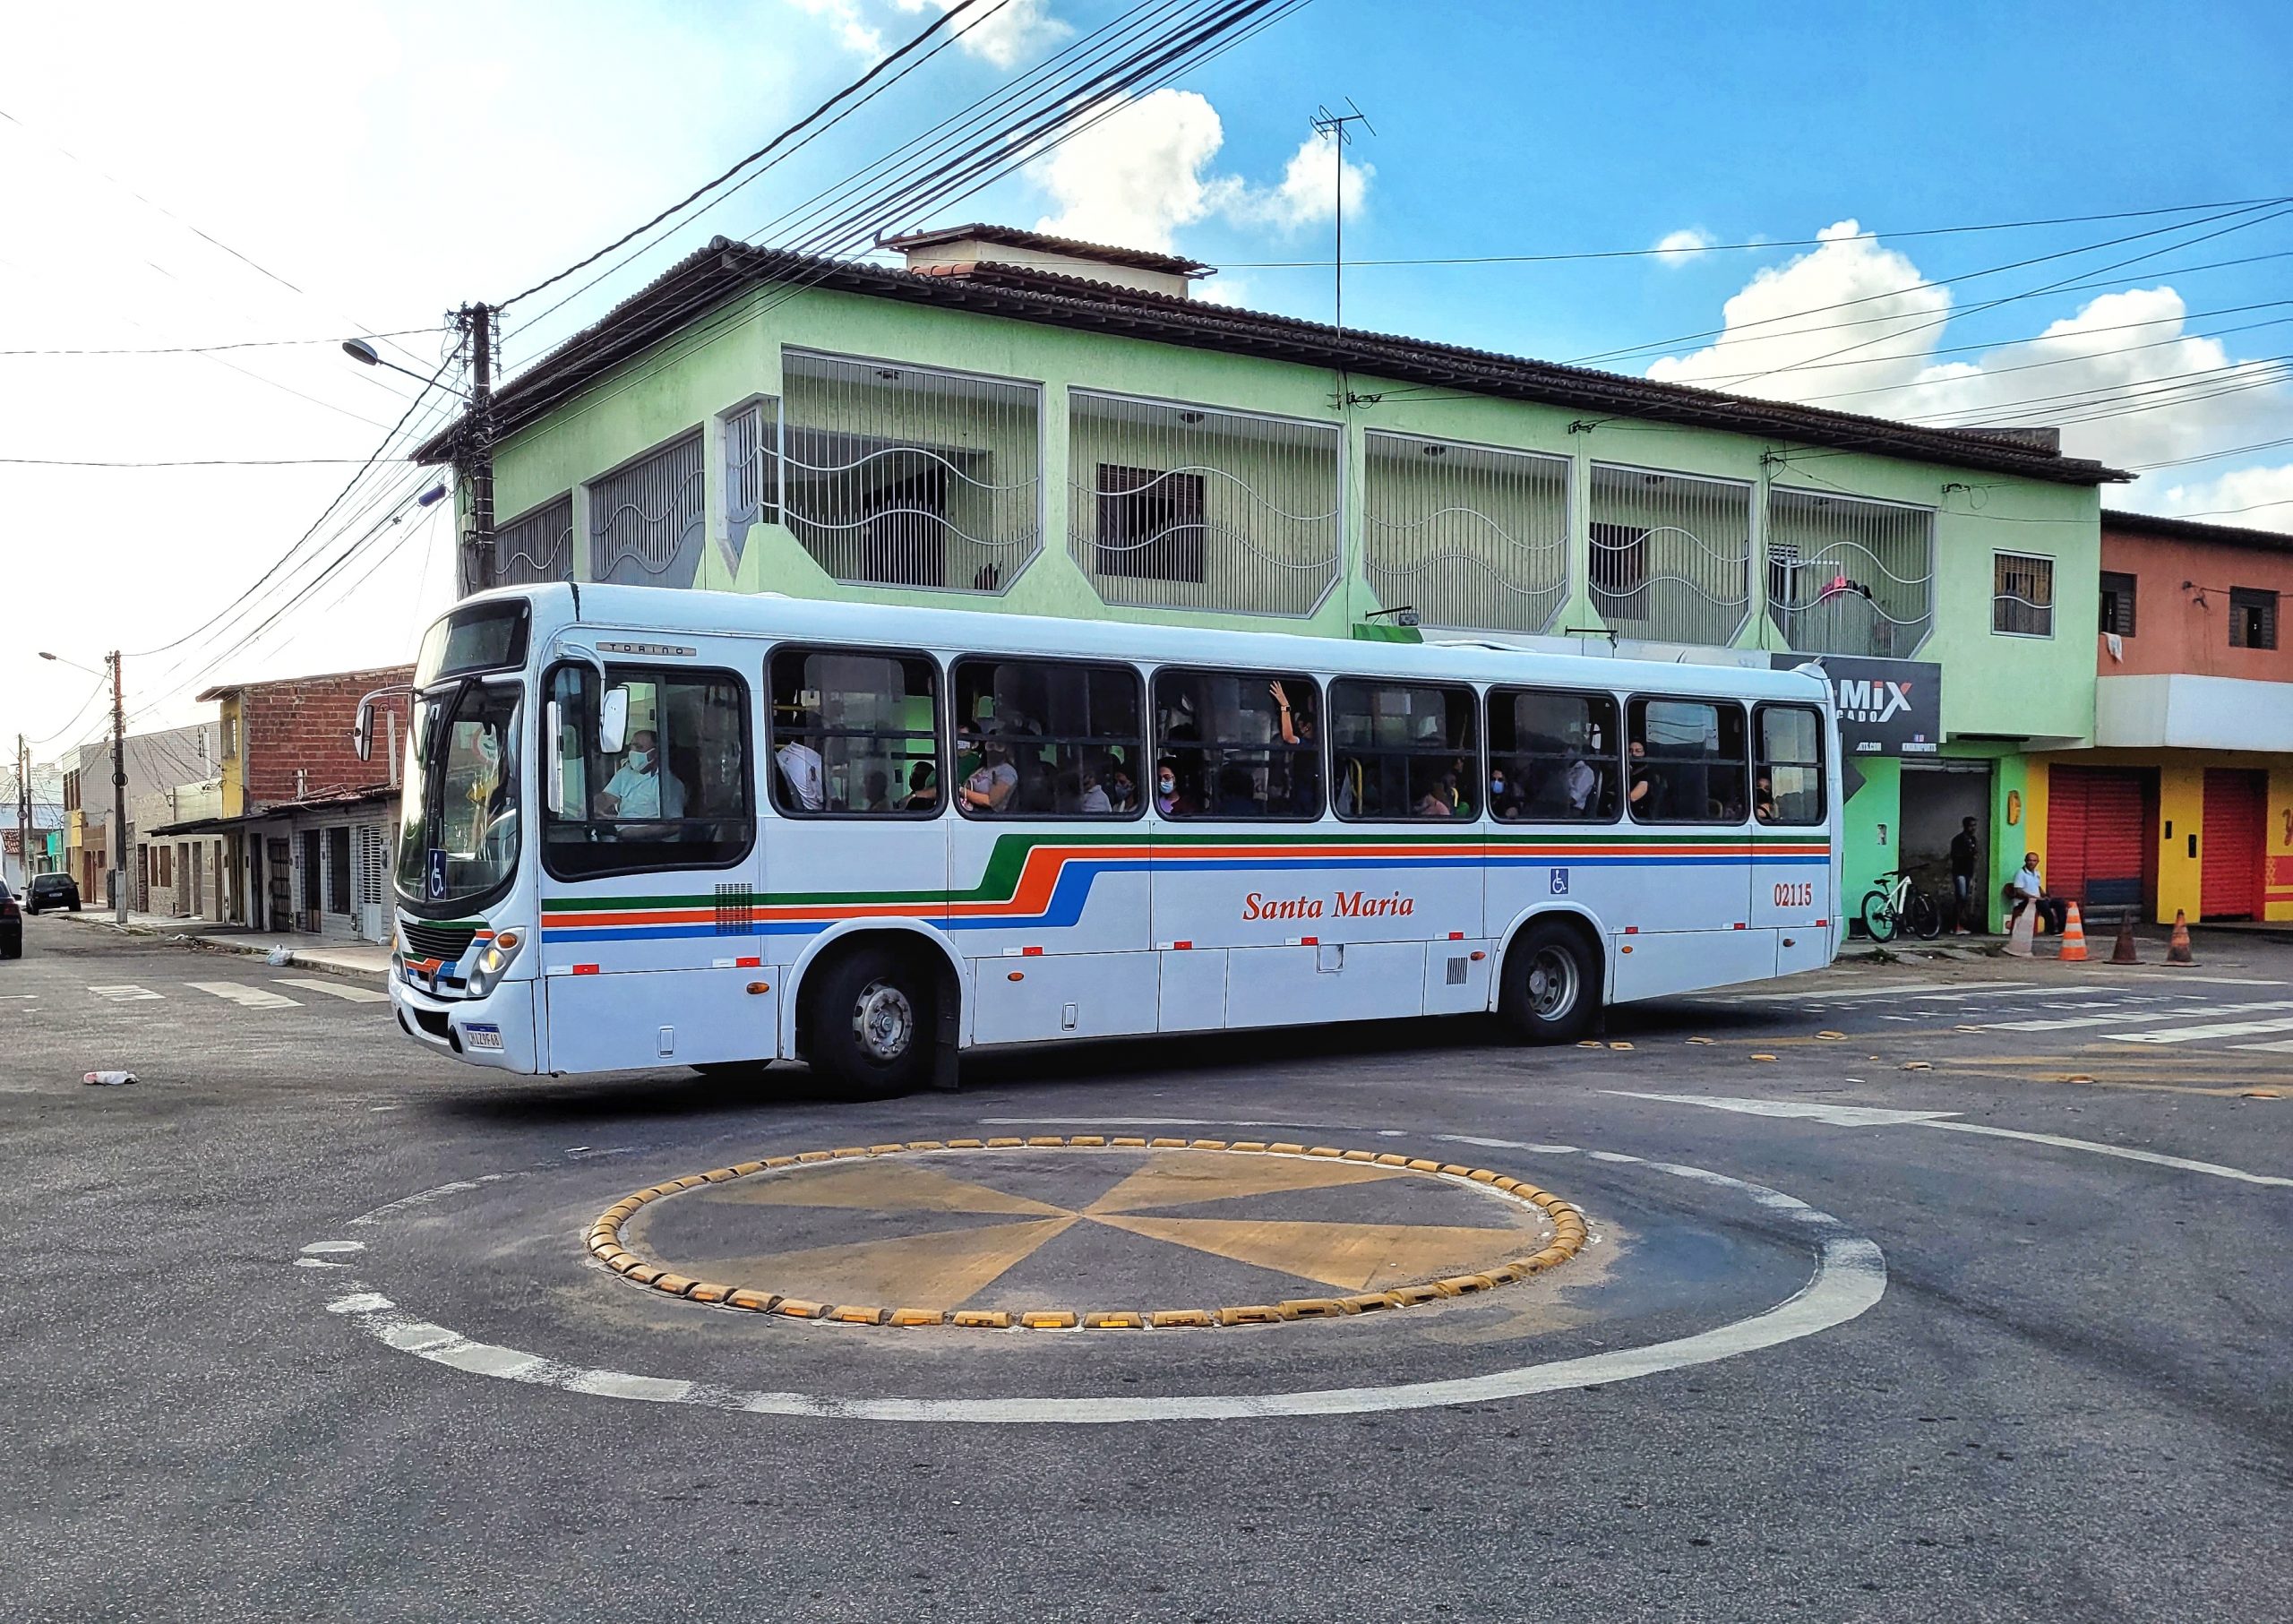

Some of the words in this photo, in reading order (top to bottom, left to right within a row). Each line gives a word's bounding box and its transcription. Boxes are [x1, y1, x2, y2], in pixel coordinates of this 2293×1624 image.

[610, 643, 683, 655] TORINO
[1242, 892, 1324, 921] Santa
[1330, 890, 1414, 918] Maria
[1773, 882, 1813, 907] 02115
